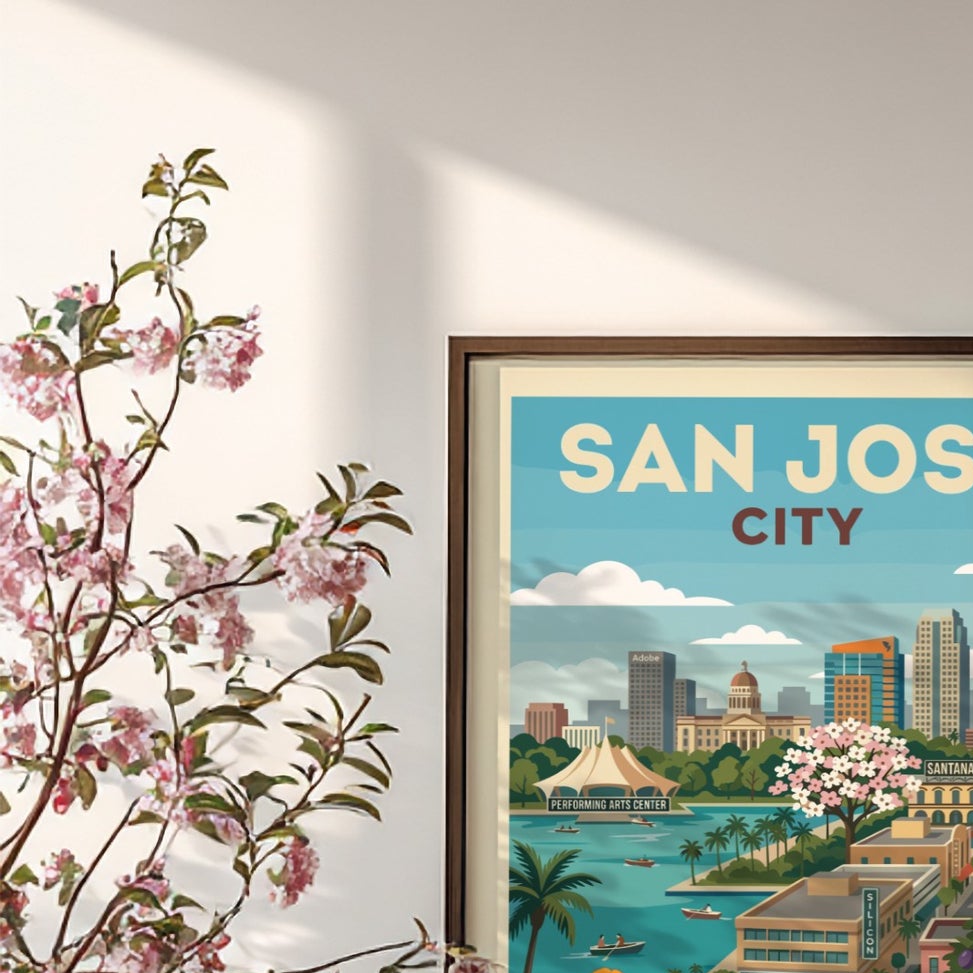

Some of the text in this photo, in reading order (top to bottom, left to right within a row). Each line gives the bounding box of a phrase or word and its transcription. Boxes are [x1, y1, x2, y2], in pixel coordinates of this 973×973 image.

[560, 423, 754, 494] SAN
[731, 507, 864, 546] CITY
[632, 653, 661, 663] Adobe
[551, 799, 667, 810] PERFORMING ARTS CENTER
[866, 893, 875, 955] SILICON
